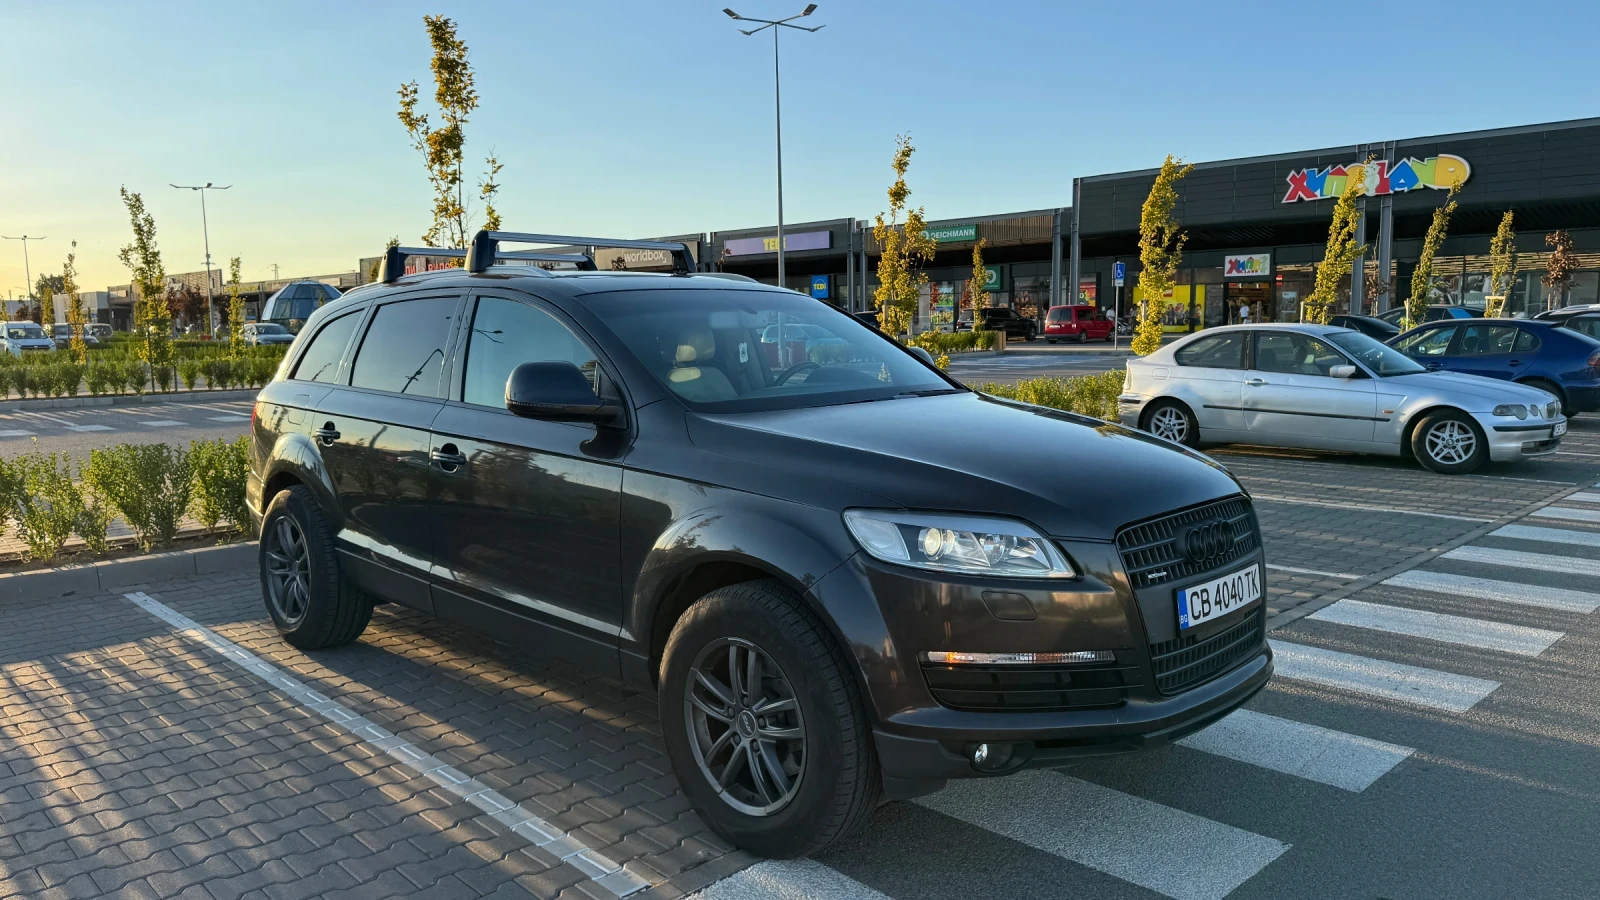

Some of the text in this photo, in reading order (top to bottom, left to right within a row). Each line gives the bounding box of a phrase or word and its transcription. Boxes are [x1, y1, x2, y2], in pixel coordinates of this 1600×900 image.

[930, 229, 975, 238] DEICHMANN
[624, 250, 664, 262] worldbox
[1190, 568, 1259, 620] CB 4040 TK
[1180, 614, 1188, 624] BG
